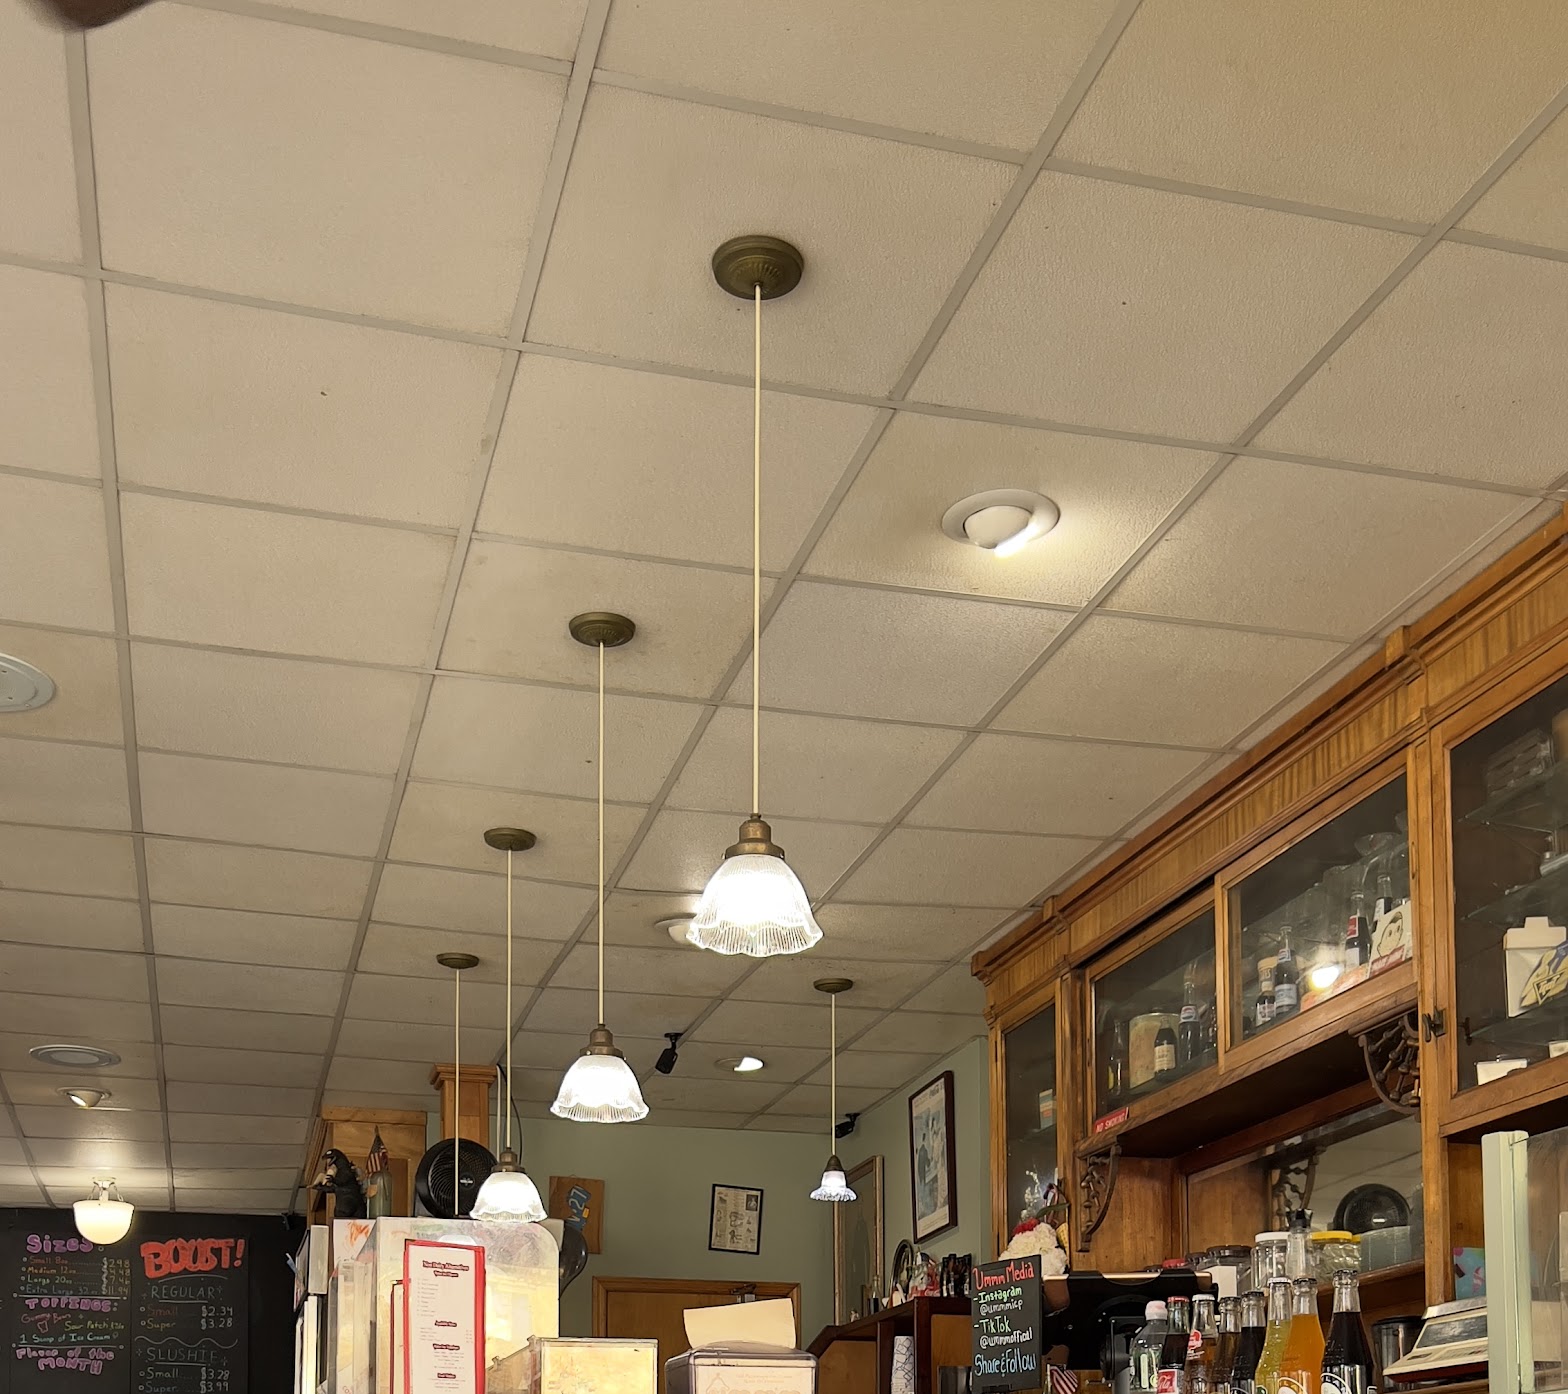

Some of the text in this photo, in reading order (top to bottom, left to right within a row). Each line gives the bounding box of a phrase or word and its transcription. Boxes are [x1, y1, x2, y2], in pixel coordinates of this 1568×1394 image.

[26, 1266, 57, 1274] Medium
[972, 1260, 1035, 1290] Ummm Media
[27, 1274, 50, 1285] Large
[26, 1284, 48, 1294] Extra
[151, 1285, 216, 1300] REGULAR
[201, 1305, 233, 1317] $2.34
[86, 1320, 109, 1329] Patch
[146, 1318, 233, 1332] Super $3.28
[20, 1334, 27, 1344] 1
[86, 1332, 111, 1341] Cream
[67, 1346, 82, 1358] of
[146, 1347, 218, 1362] SLUSHIE
[38, 1357, 103, 1376] MONTH
[974, 1353, 1000, 1377] Share
[146, 1366, 230, 1381] Small $3.28
[199, 1380, 229, 1394] $3.99
